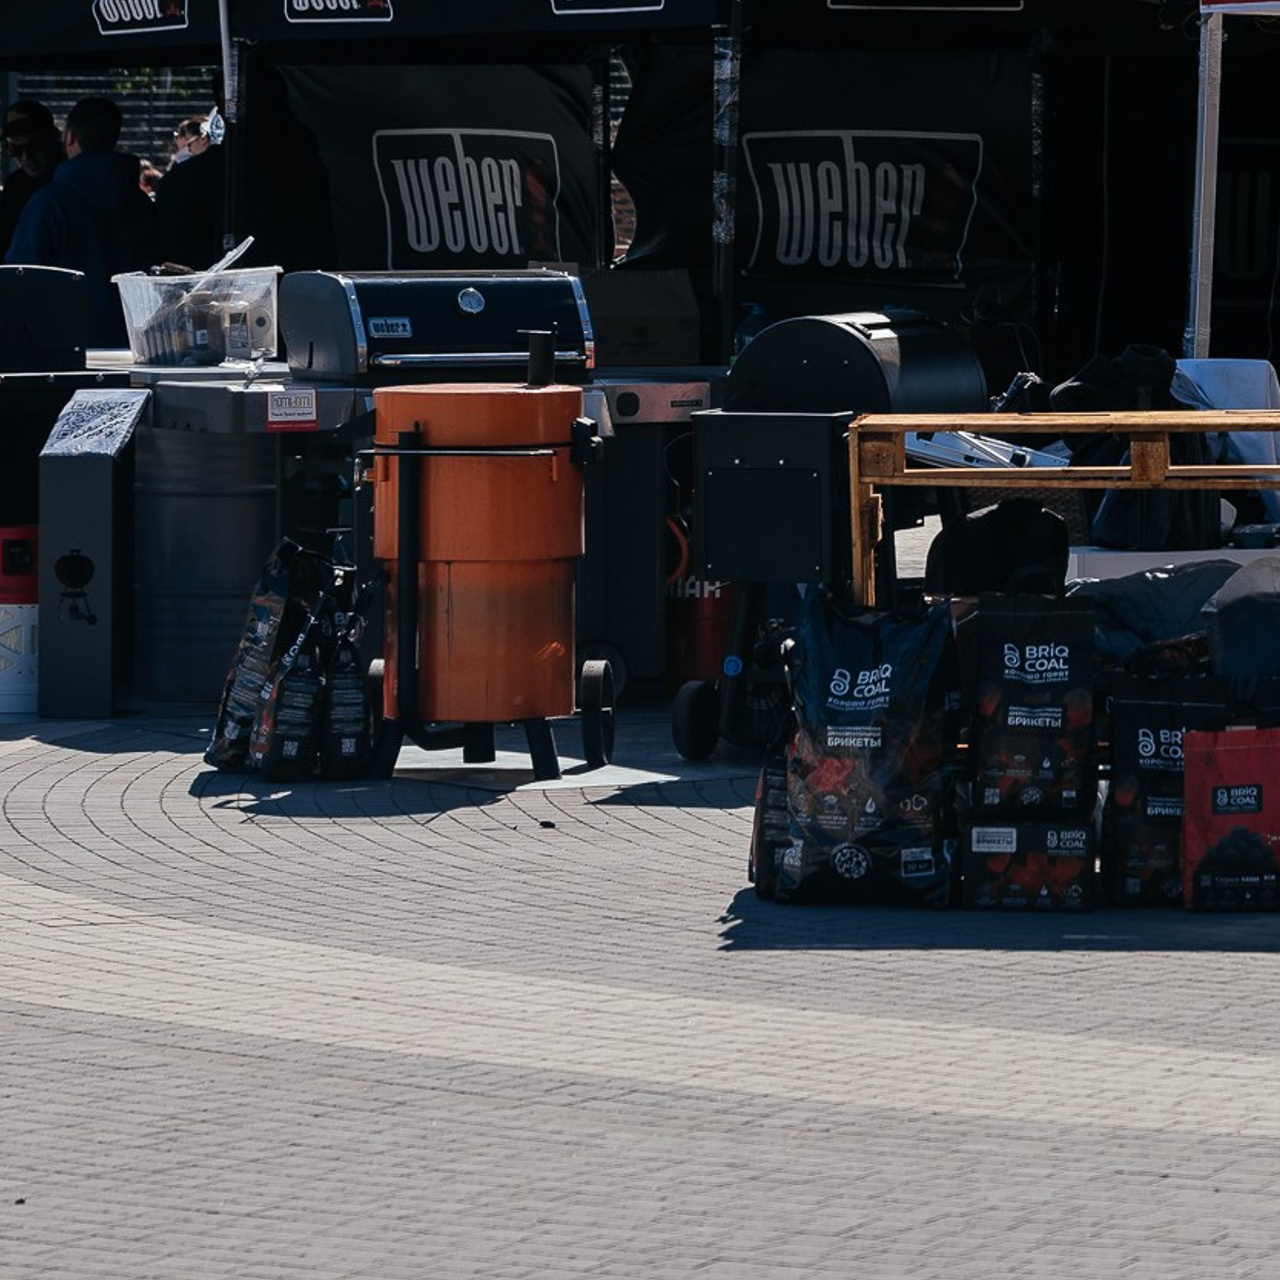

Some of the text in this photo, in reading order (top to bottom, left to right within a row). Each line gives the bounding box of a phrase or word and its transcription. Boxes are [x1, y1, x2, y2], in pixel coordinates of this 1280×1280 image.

[390, 138, 523, 255] weber
[767, 140, 926, 269] weber
[1024, 658, 1069, 672] COAL
[853, 679, 891, 698] COAL
[1007, 716, 1062, 727] БРИКЕТЫ
[827, 736, 882, 747] БРИКЕТЫ
[1230, 796, 1257, 806] COAL
[1060, 839, 1085, 848] COAL
